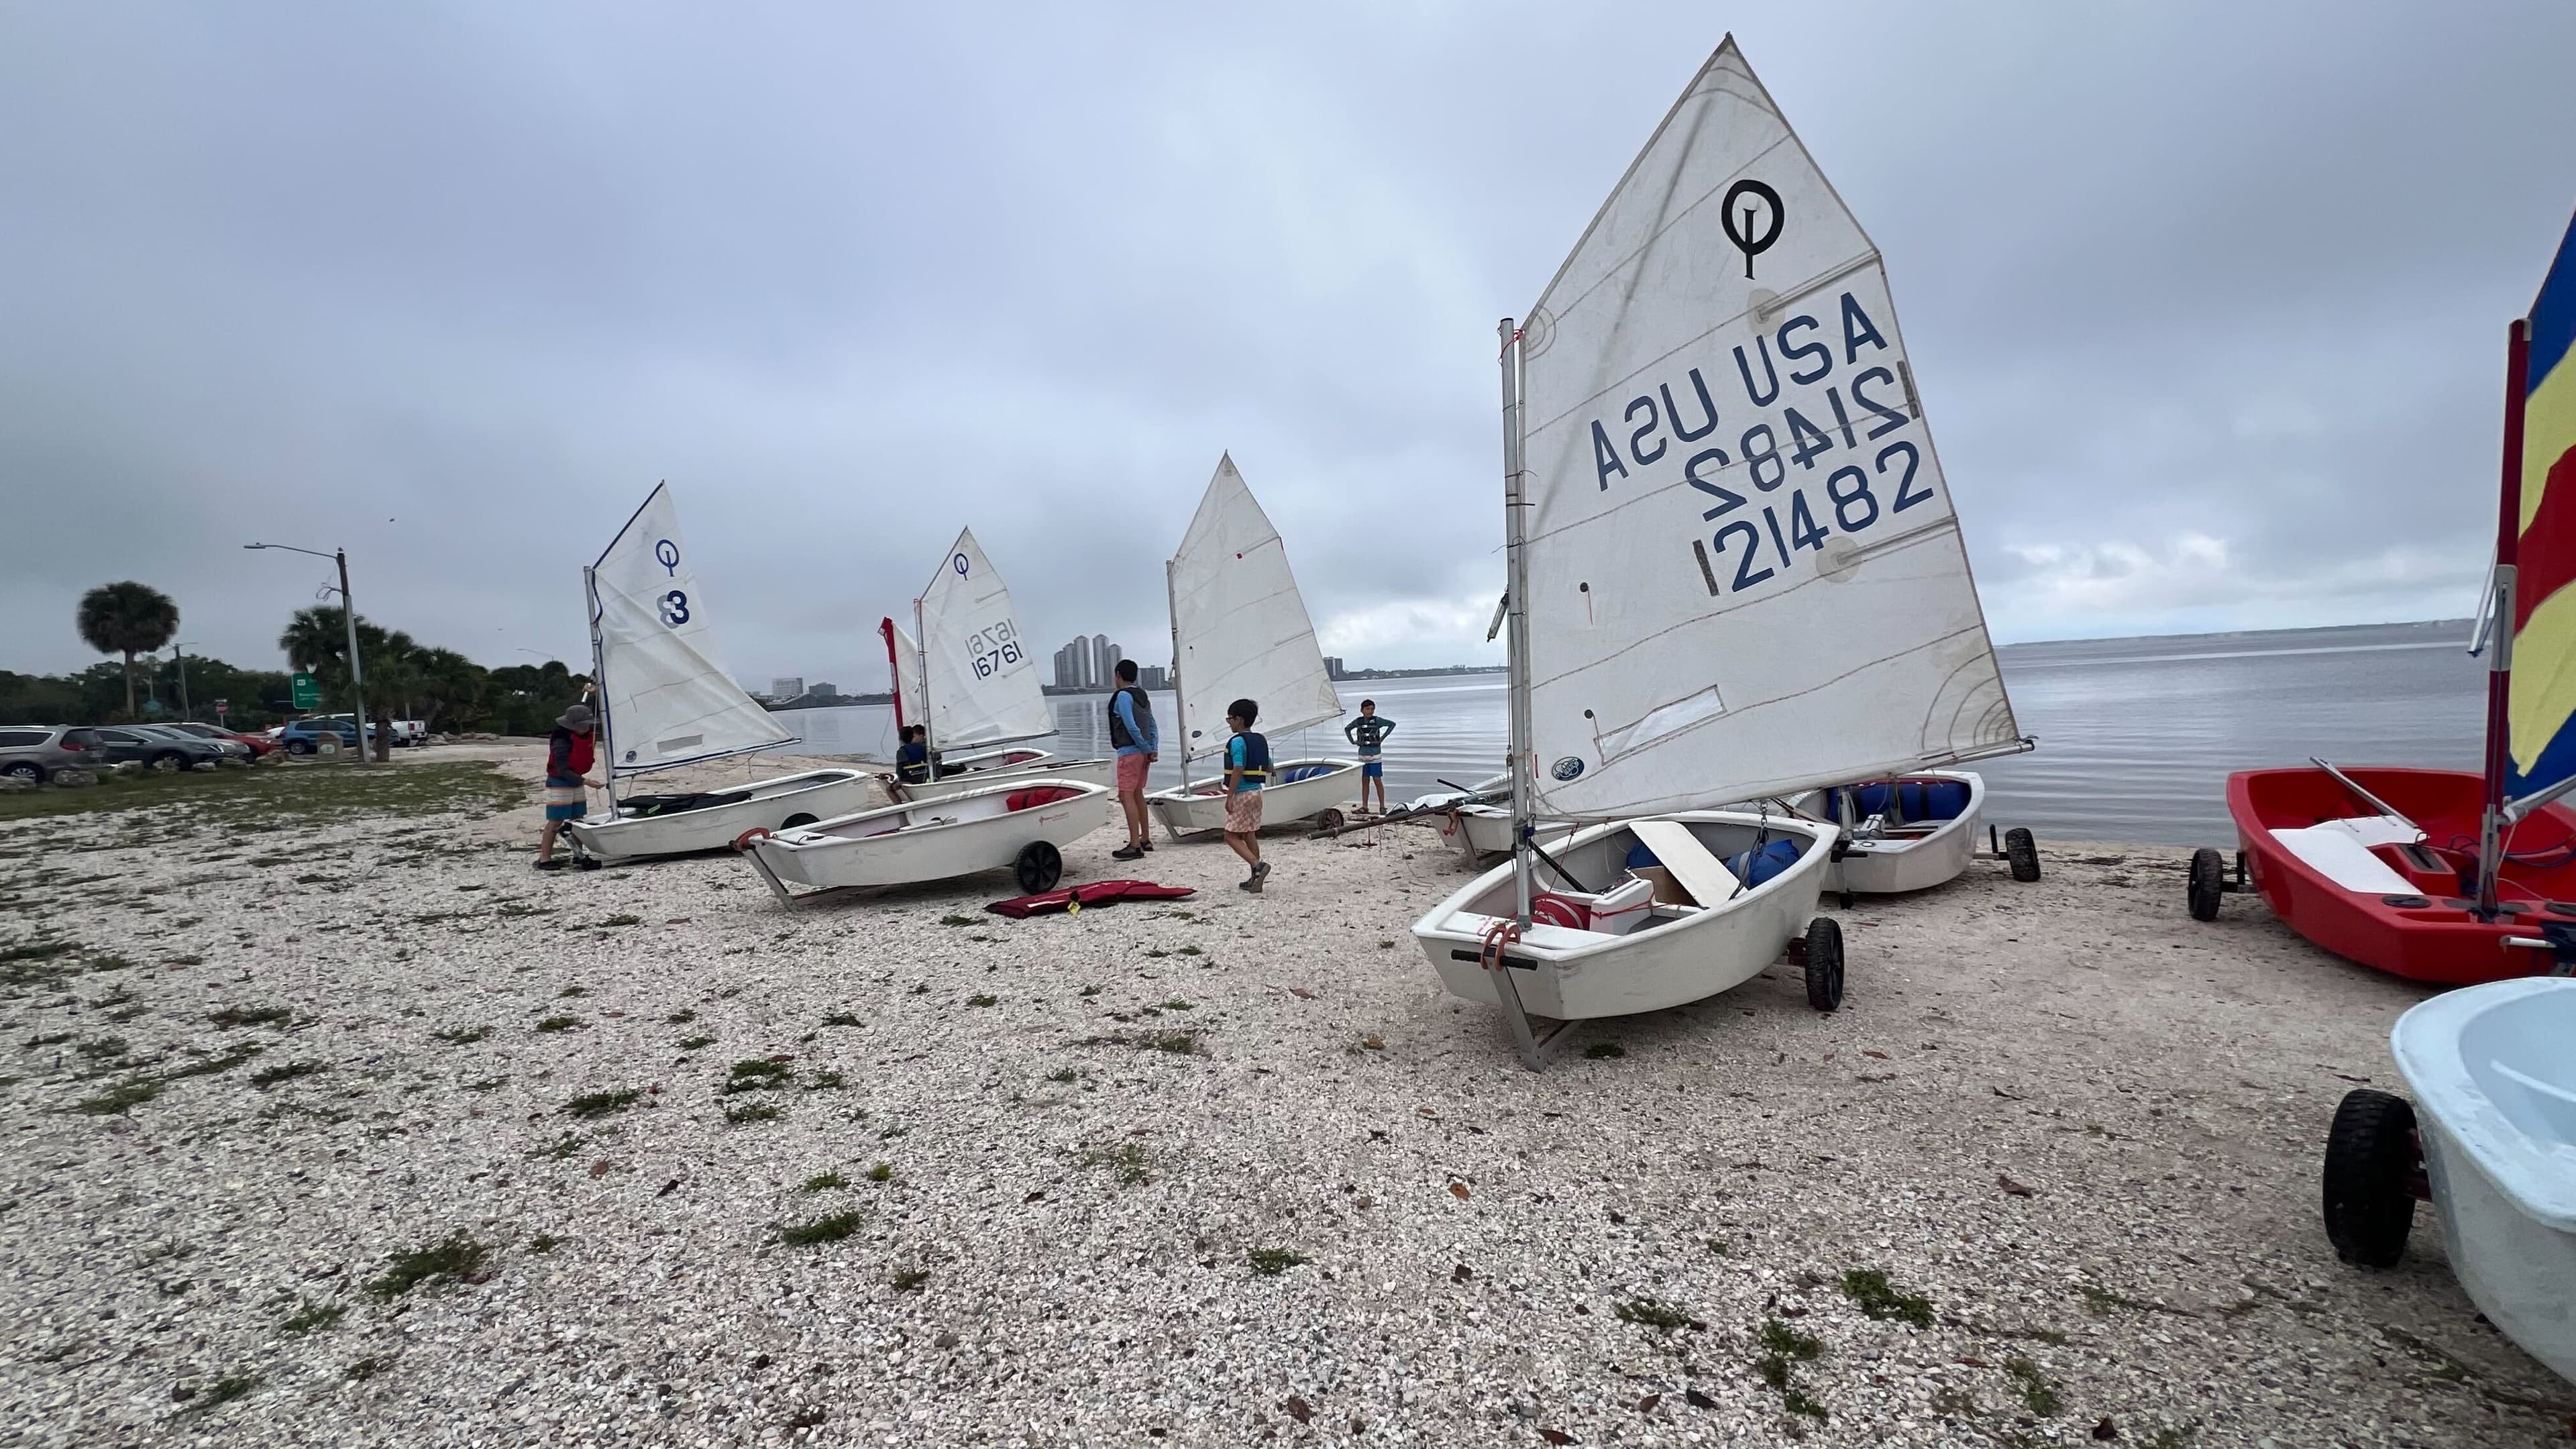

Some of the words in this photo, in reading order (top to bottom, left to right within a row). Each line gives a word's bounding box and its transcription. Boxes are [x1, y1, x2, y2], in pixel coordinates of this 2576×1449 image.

[1733, 292, 1888, 407] USA
[1693, 441, 1934, 596] 121482
[667, 590, 689, 625] 3
[971, 641, 1023, 680] 16761
